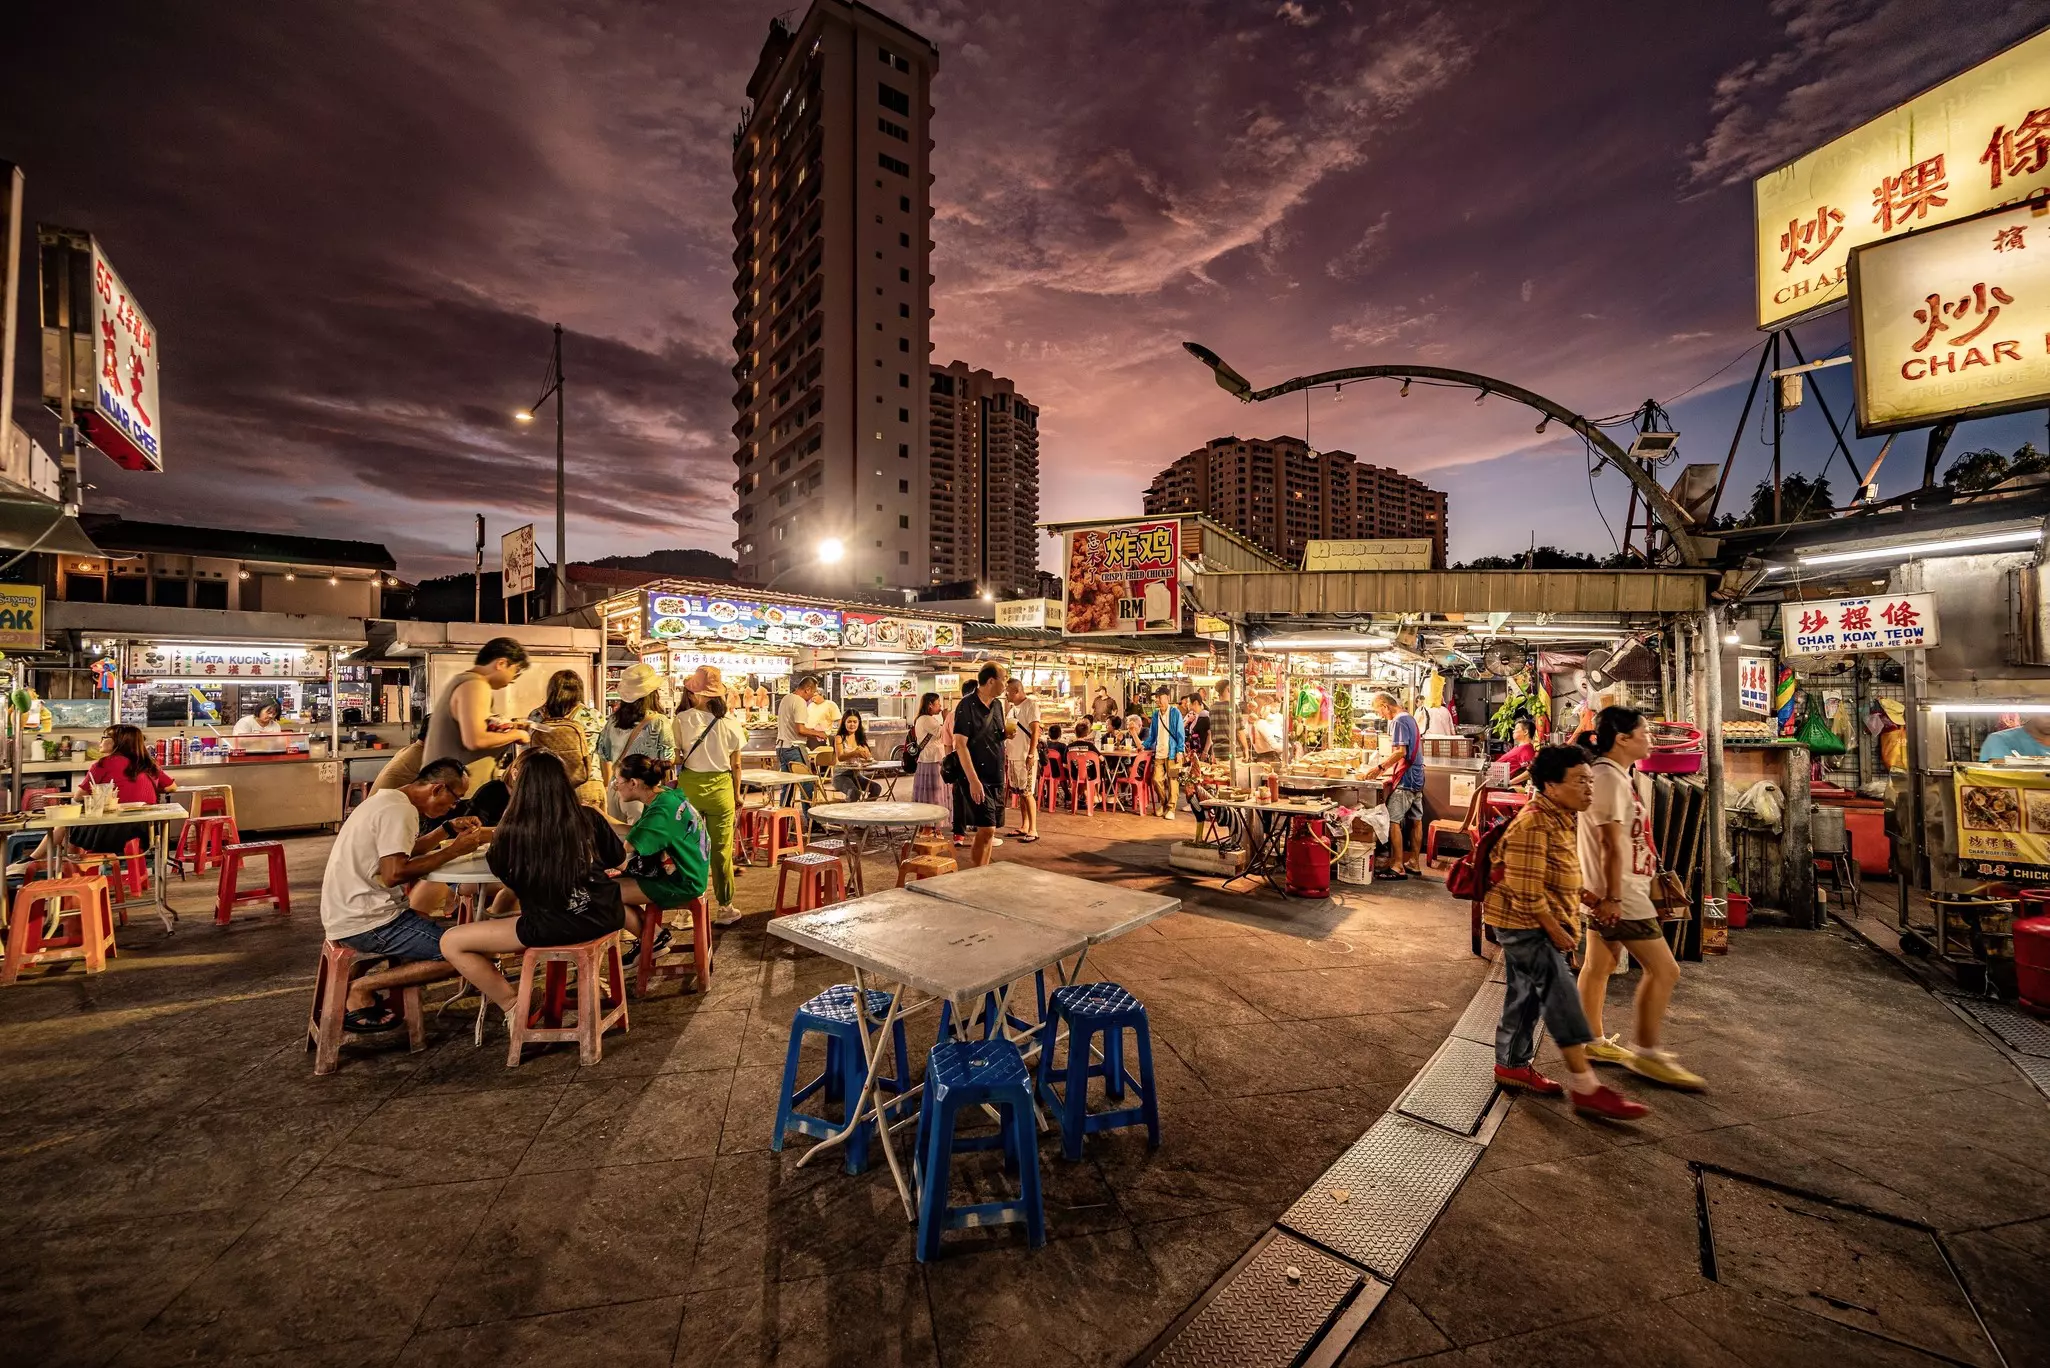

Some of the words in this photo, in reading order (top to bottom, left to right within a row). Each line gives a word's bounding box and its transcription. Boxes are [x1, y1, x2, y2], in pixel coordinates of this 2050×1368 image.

[96, 258, 113, 305] 55
[1912, 281, 2015, 353] 炒
[1901, 339, 2023, 381] CHAR
[132, 425, 158, 457] CHEE
[1104, 526, 1173, 569] 炸鸡
[1101, 572, 1123, 582] CRISPY
[1125, 571, 1145, 580] FRIED
[1146, 568, 1174, 579] CHICKEN
[1119, 598, 1145, 619] RM
[1798, 600, 1921, 634] 炒粿條
[1797, 634, 1835, 646] CHAR
[1843, 630, 1878, 642] KOAY
[1884, 627, 1924, 639] TEOW
[195, 655, 225, 665] MATA
[228, 655, 272, 666] KUCING
